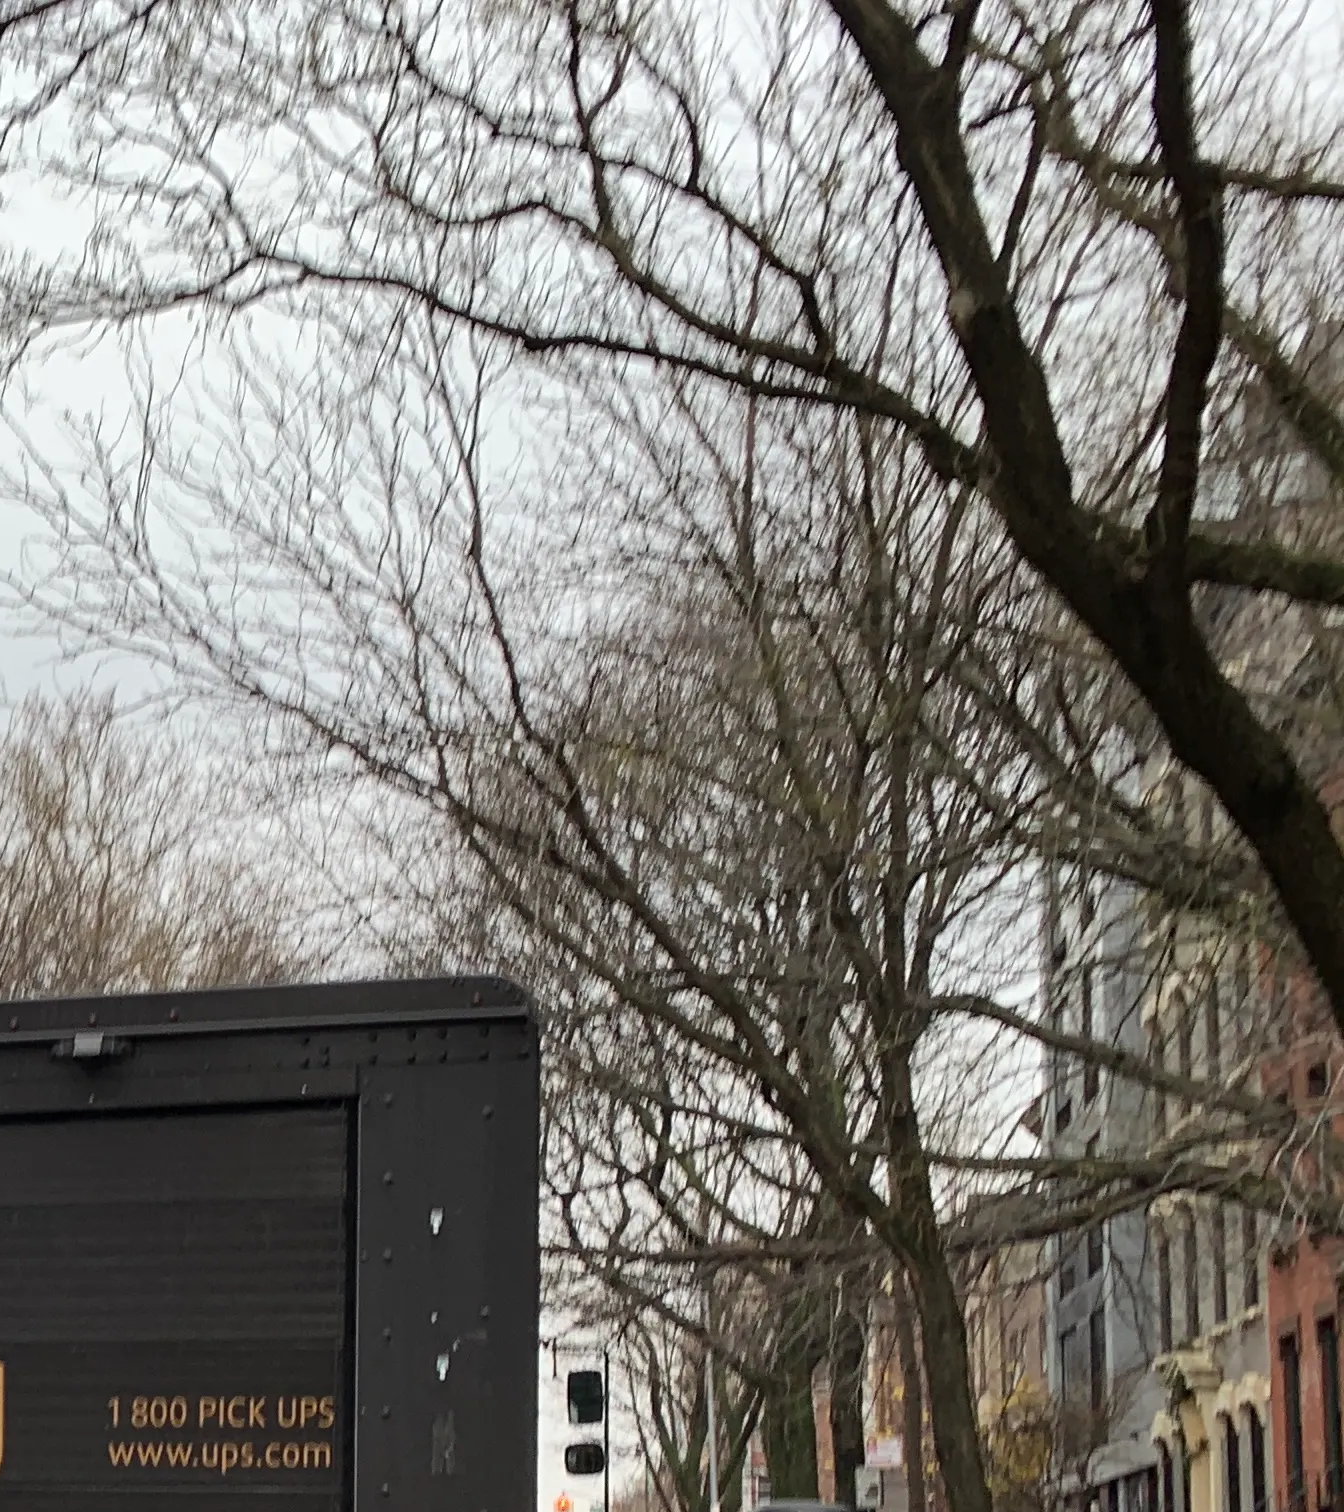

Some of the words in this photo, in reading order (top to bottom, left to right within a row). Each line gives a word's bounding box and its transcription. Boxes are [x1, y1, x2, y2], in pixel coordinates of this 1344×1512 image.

[108, 1395, 120, 1429] 1
[131, 1395, 188, 1429] 800
[198, 1395, 267, 1429] PICK
[277, 1394, 336, 1429] UPS
[108, 1441, 332, 1477] www.ups.com
